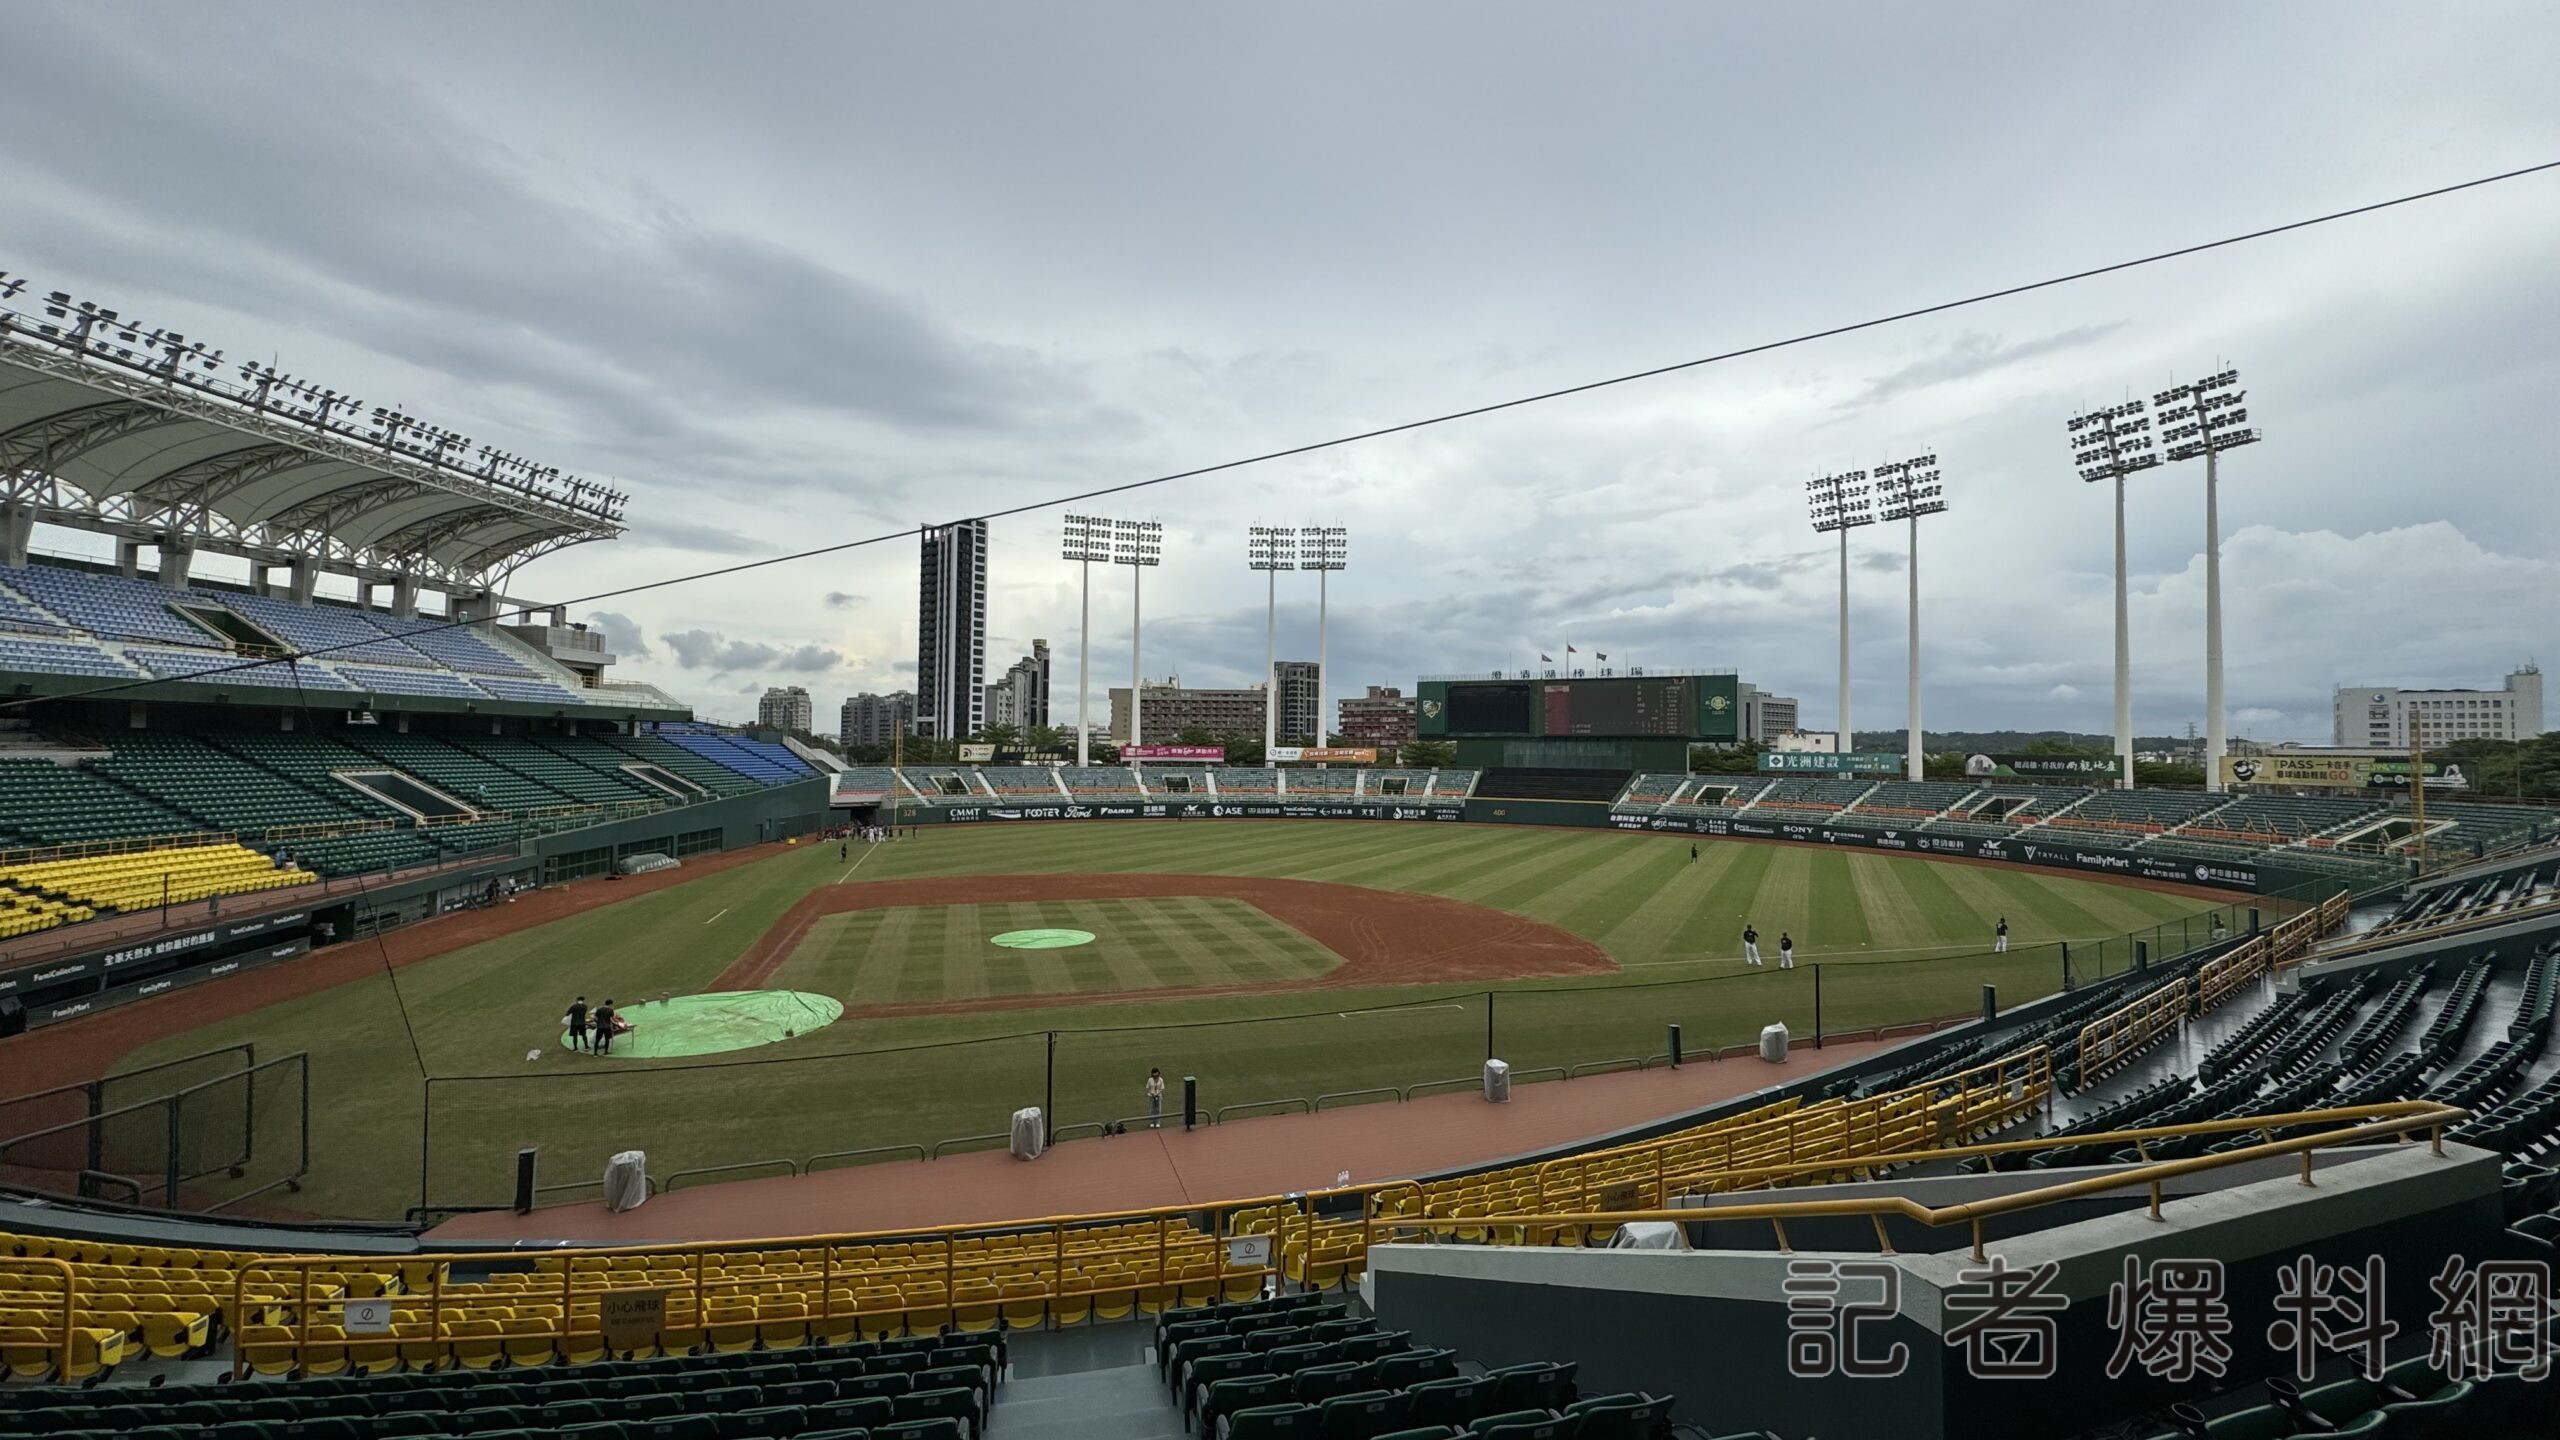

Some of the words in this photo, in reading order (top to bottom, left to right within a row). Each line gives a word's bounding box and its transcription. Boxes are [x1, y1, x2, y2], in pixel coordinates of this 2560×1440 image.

[950, 808, 981, 817] CMMT
[1025, 808, 1060, 818] FOOTER
[1064, 805, 1092, 818] Ford
[1225, 806, 1243, 815] ASE
[1783, 825, 1814, 834] SONY
[2037, 851, 2070, 861] TRYALL
[2076, 852, 2129, 868] FamilyMart
[230, 923, 265, 936] FamiCollection
[33, 963, 85, 982] FamiCollection
[211, 961, 239, 975] FamilyMart
[139, 980, 171, 995] FamilyMart
[52, 1002, 90, 1018] FamilyMart
